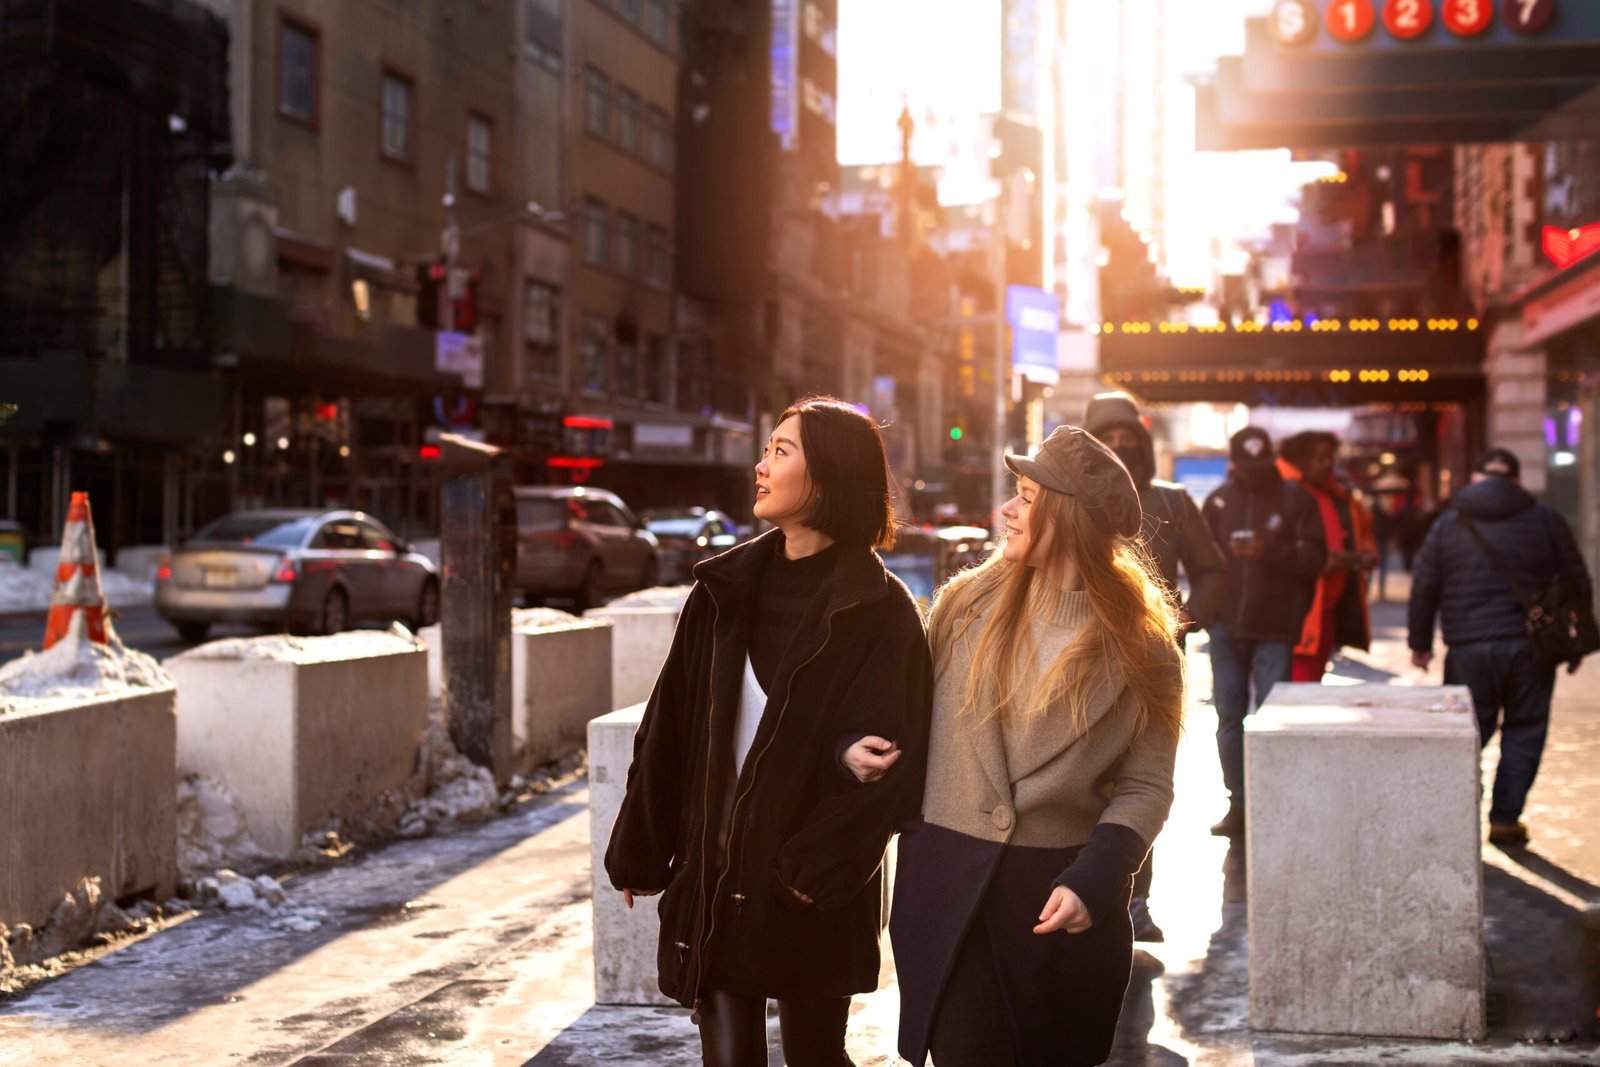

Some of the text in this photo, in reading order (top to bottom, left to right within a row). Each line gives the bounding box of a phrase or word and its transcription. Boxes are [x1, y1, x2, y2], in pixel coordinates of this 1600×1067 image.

[1277, 0, 1538, 36] S 1 2 3 7
